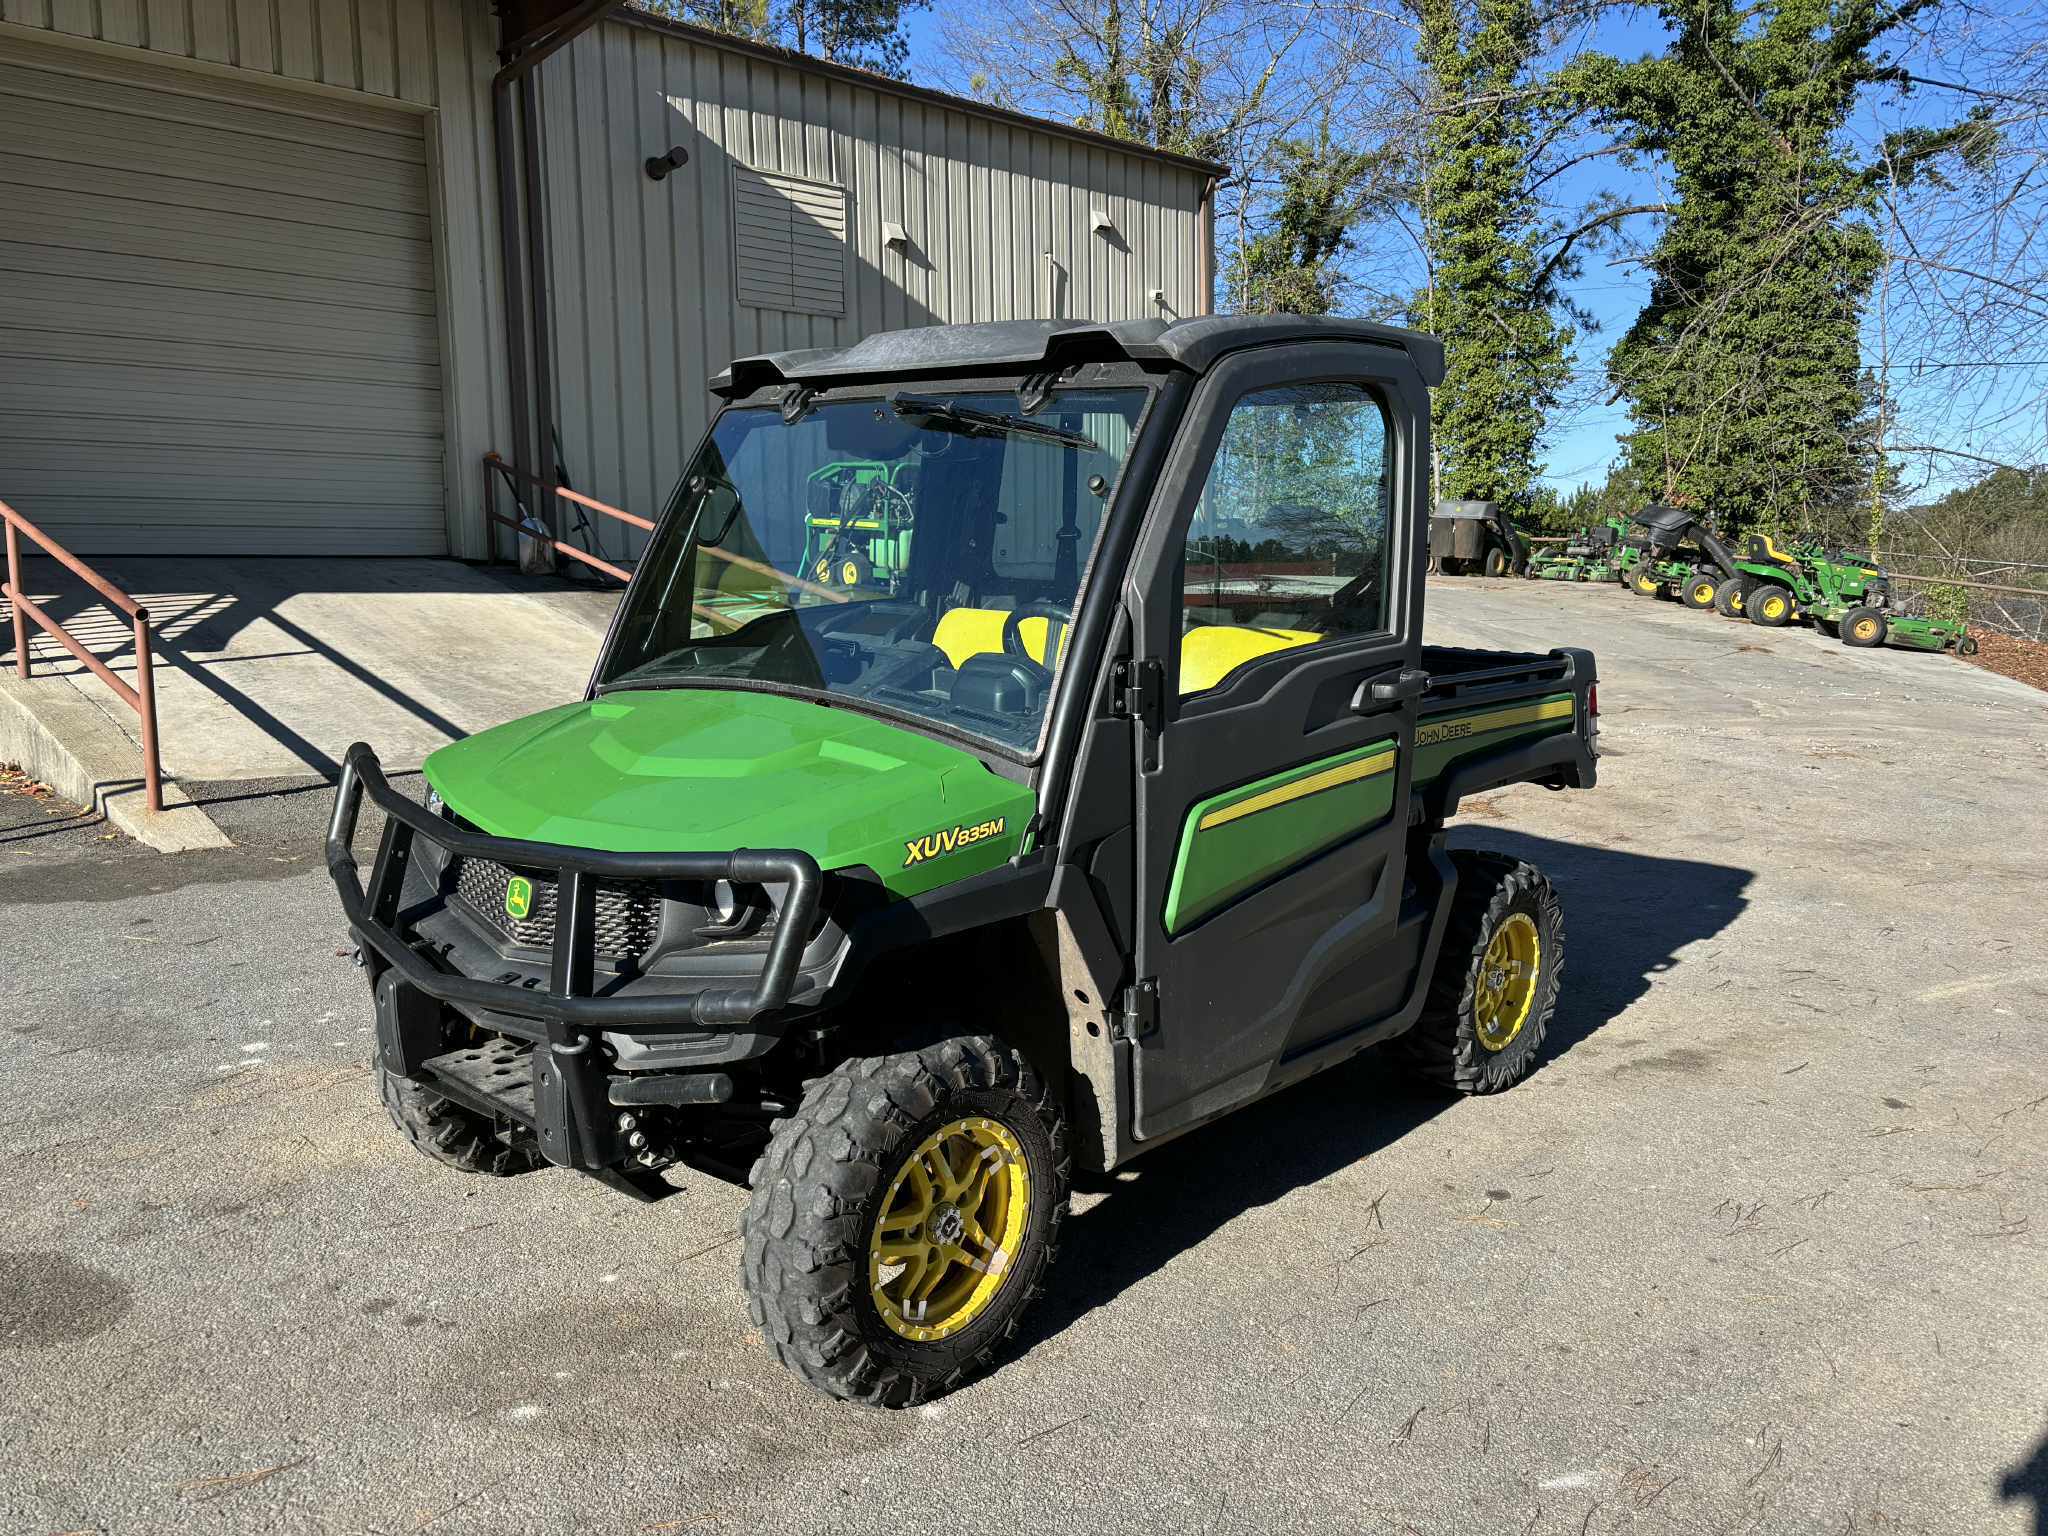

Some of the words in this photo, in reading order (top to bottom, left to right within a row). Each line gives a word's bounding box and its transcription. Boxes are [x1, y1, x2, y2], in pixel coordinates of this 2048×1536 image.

[1414, 727, 1440, 747] JOHN
[1441, 722, 1472, 740] DEERE
[903, 816, 1005, 867] XUV835M
